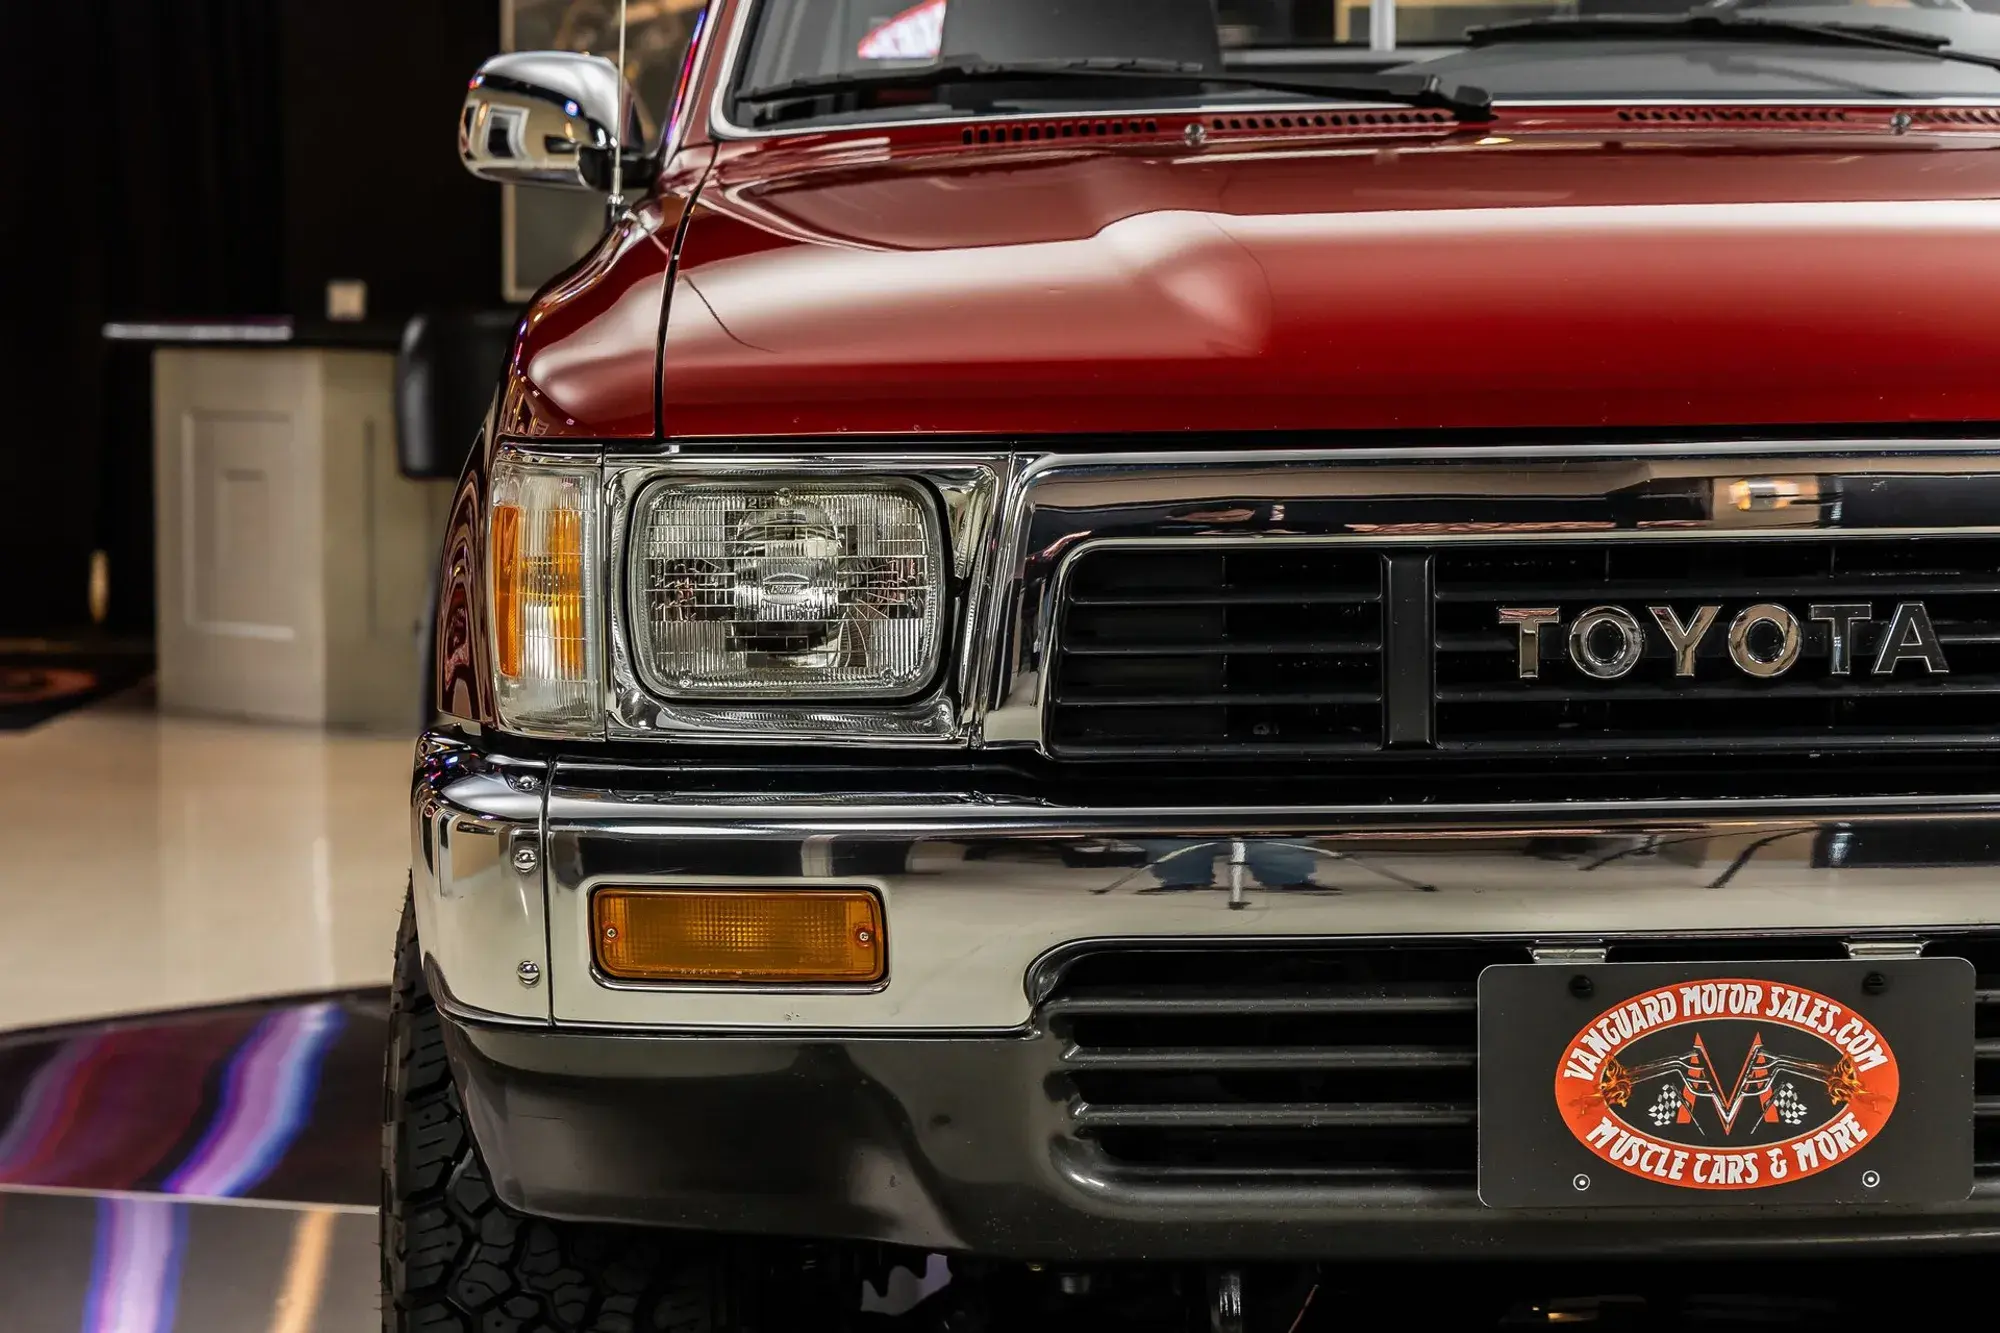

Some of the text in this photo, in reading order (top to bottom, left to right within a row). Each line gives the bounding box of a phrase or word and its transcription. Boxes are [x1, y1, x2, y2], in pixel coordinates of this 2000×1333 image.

[1498, 602, 1950, 679] TOYOTA
[1563, 983, 1889, 1082] VANGUARD MOTOR SALES.COM
[1586, 1111, 1870, 1185] MUSCLE CARS & MORE
